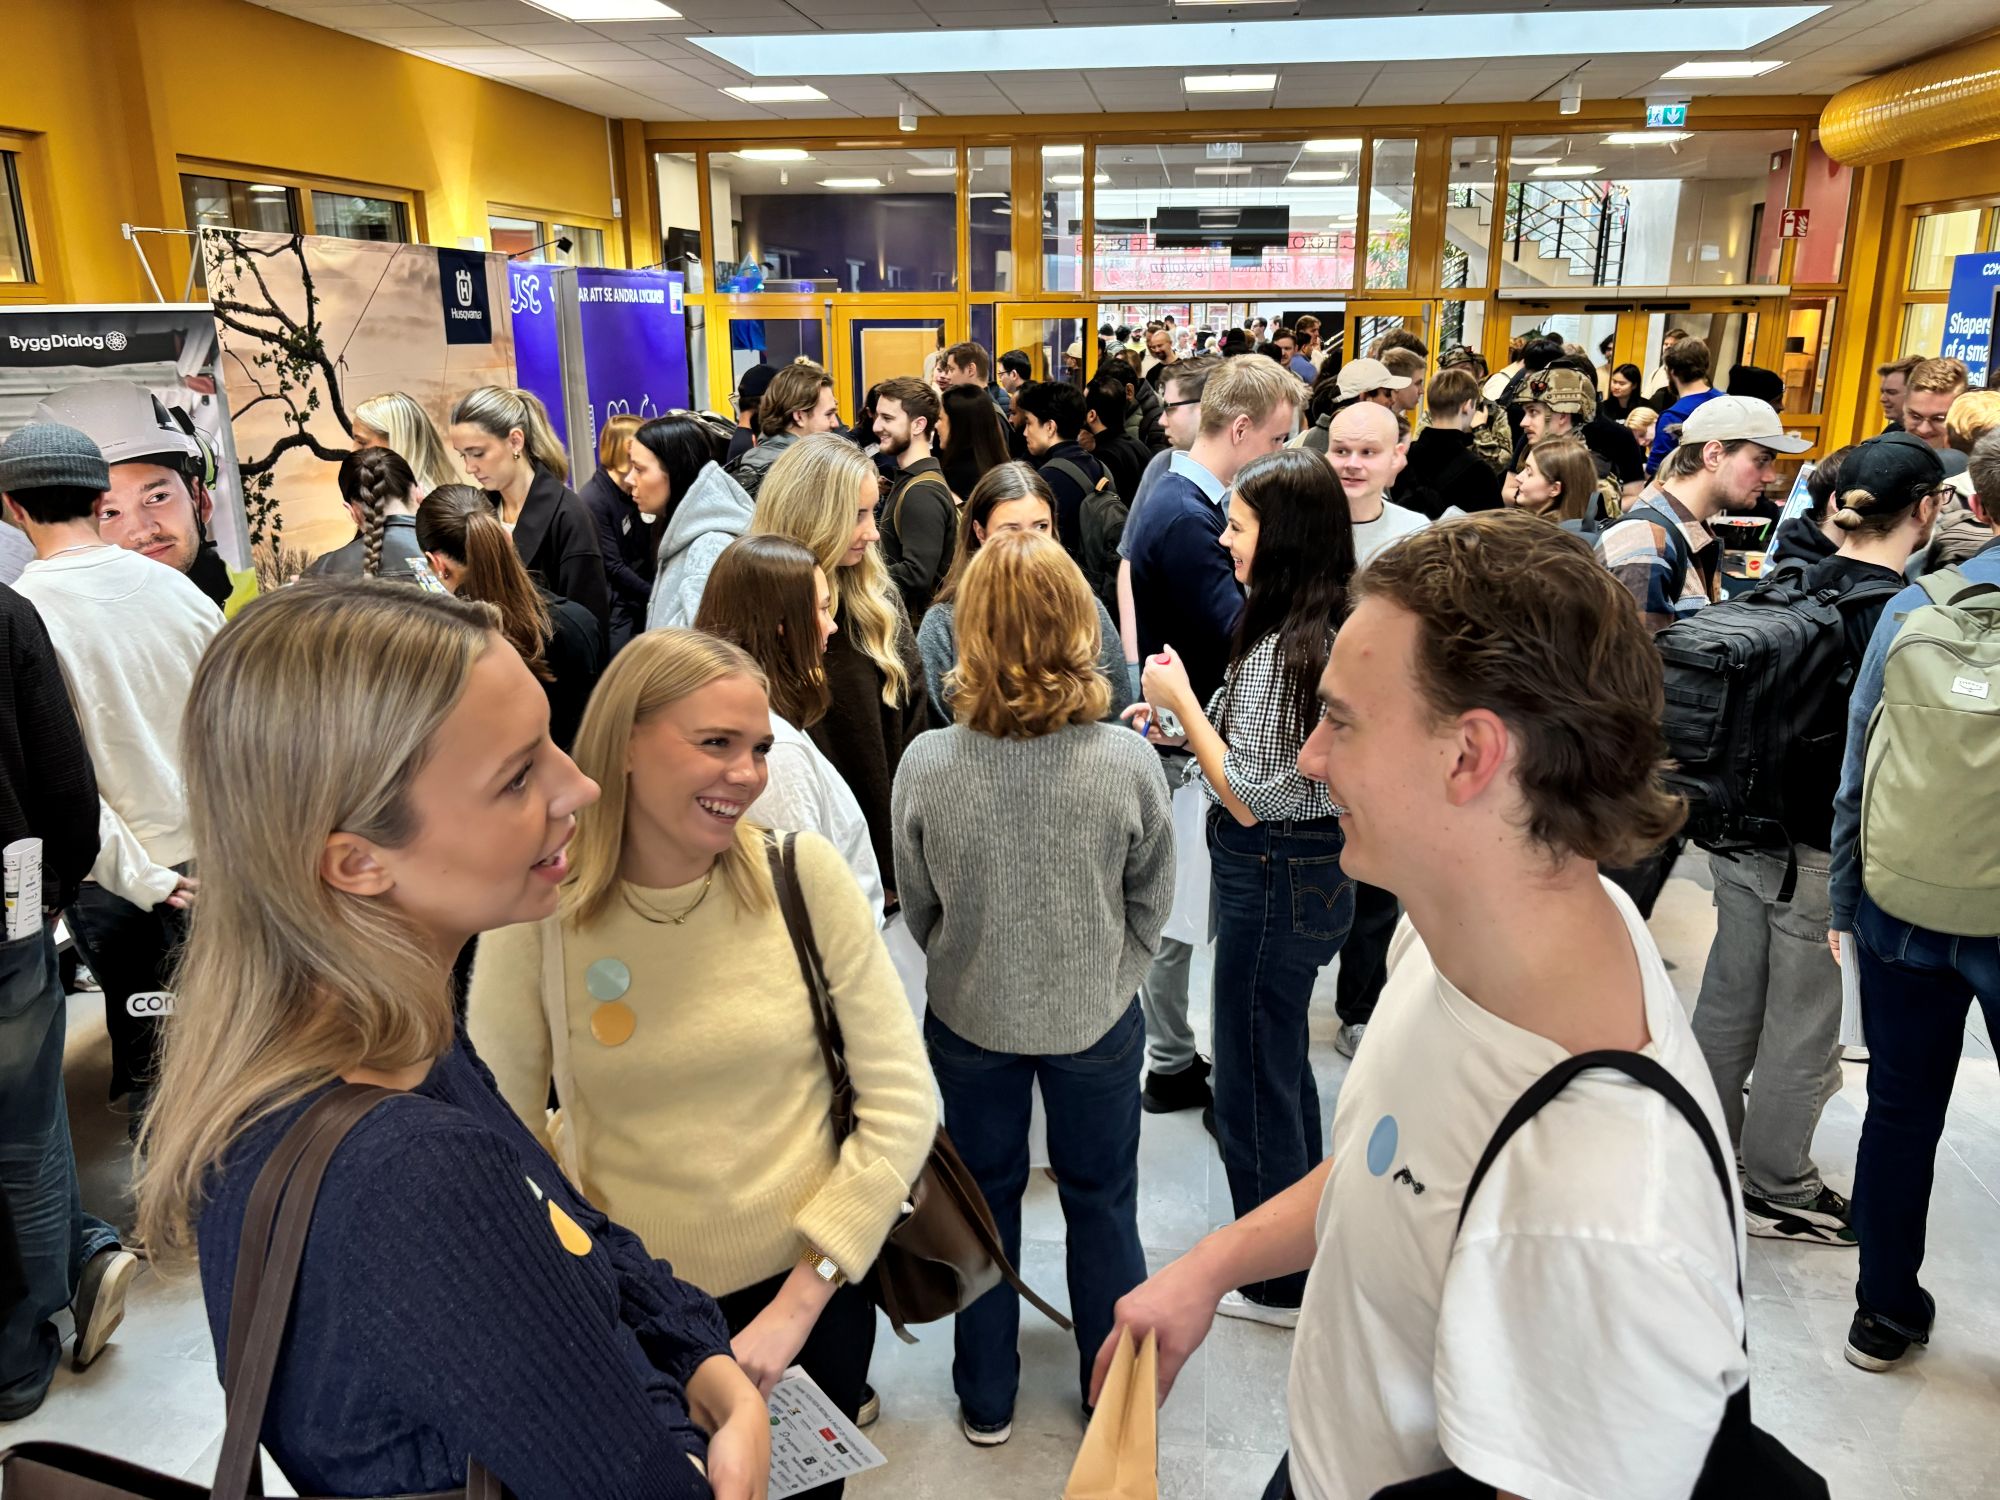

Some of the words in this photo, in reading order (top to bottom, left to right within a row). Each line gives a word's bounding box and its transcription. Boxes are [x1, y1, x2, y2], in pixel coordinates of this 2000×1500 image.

[590, 287, 603, 302] ATT
[604, 287, 613, 302] SE
[614, 288, 638, 303] ANDRA
[1949, 312, 1991, 340] Shapers
[9, 334, 104, 352] ByggDialog
[1945, 338, 1959, 358] of
[1957, 344, 1965, 361] a
